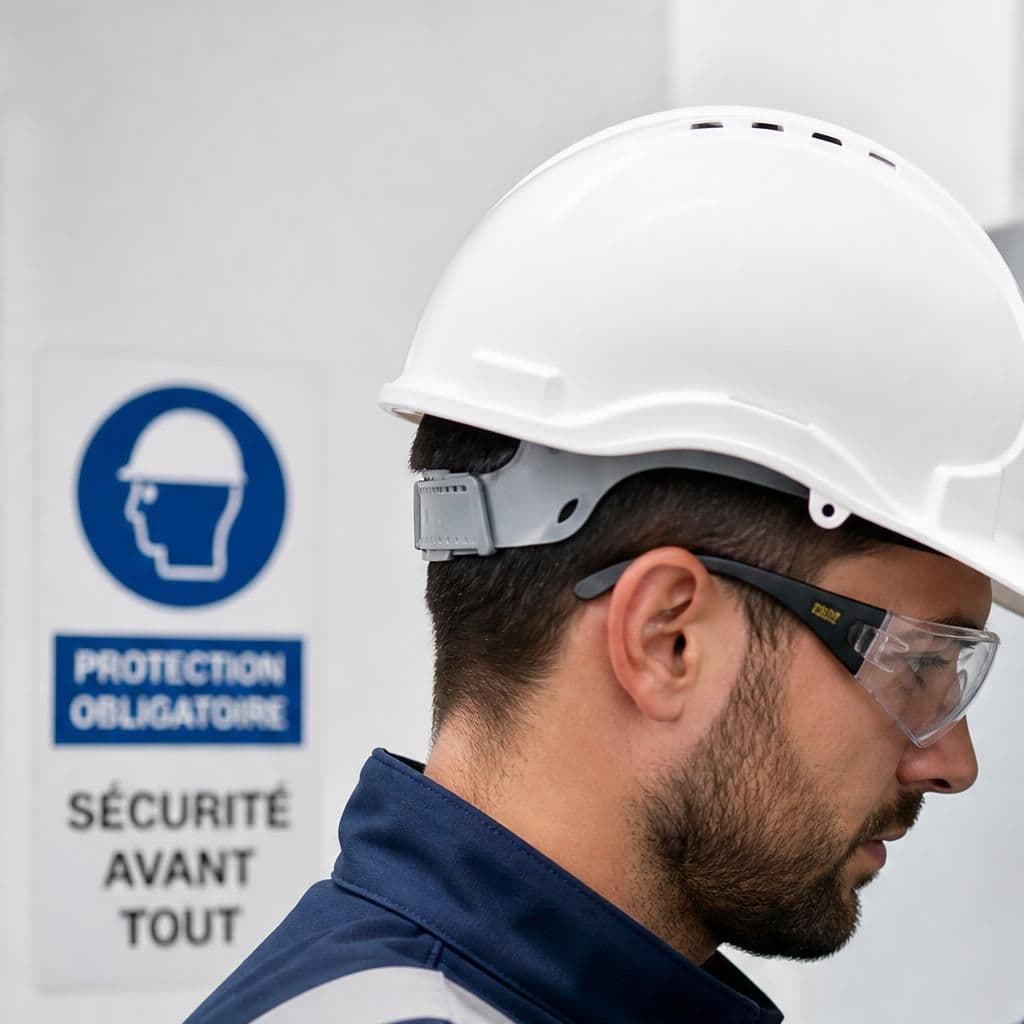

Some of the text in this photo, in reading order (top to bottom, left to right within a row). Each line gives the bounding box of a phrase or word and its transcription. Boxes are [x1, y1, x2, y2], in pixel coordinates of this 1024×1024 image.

[73, 649, 286, 686] PROTECTION
[70, 694, 287, 731] OBLIGATOIRE
[68, 782, 290, 831] SÉCURITÉ
[104, 849, 255, 889] AVANT
[120, 907, 241, 948] TOUT
